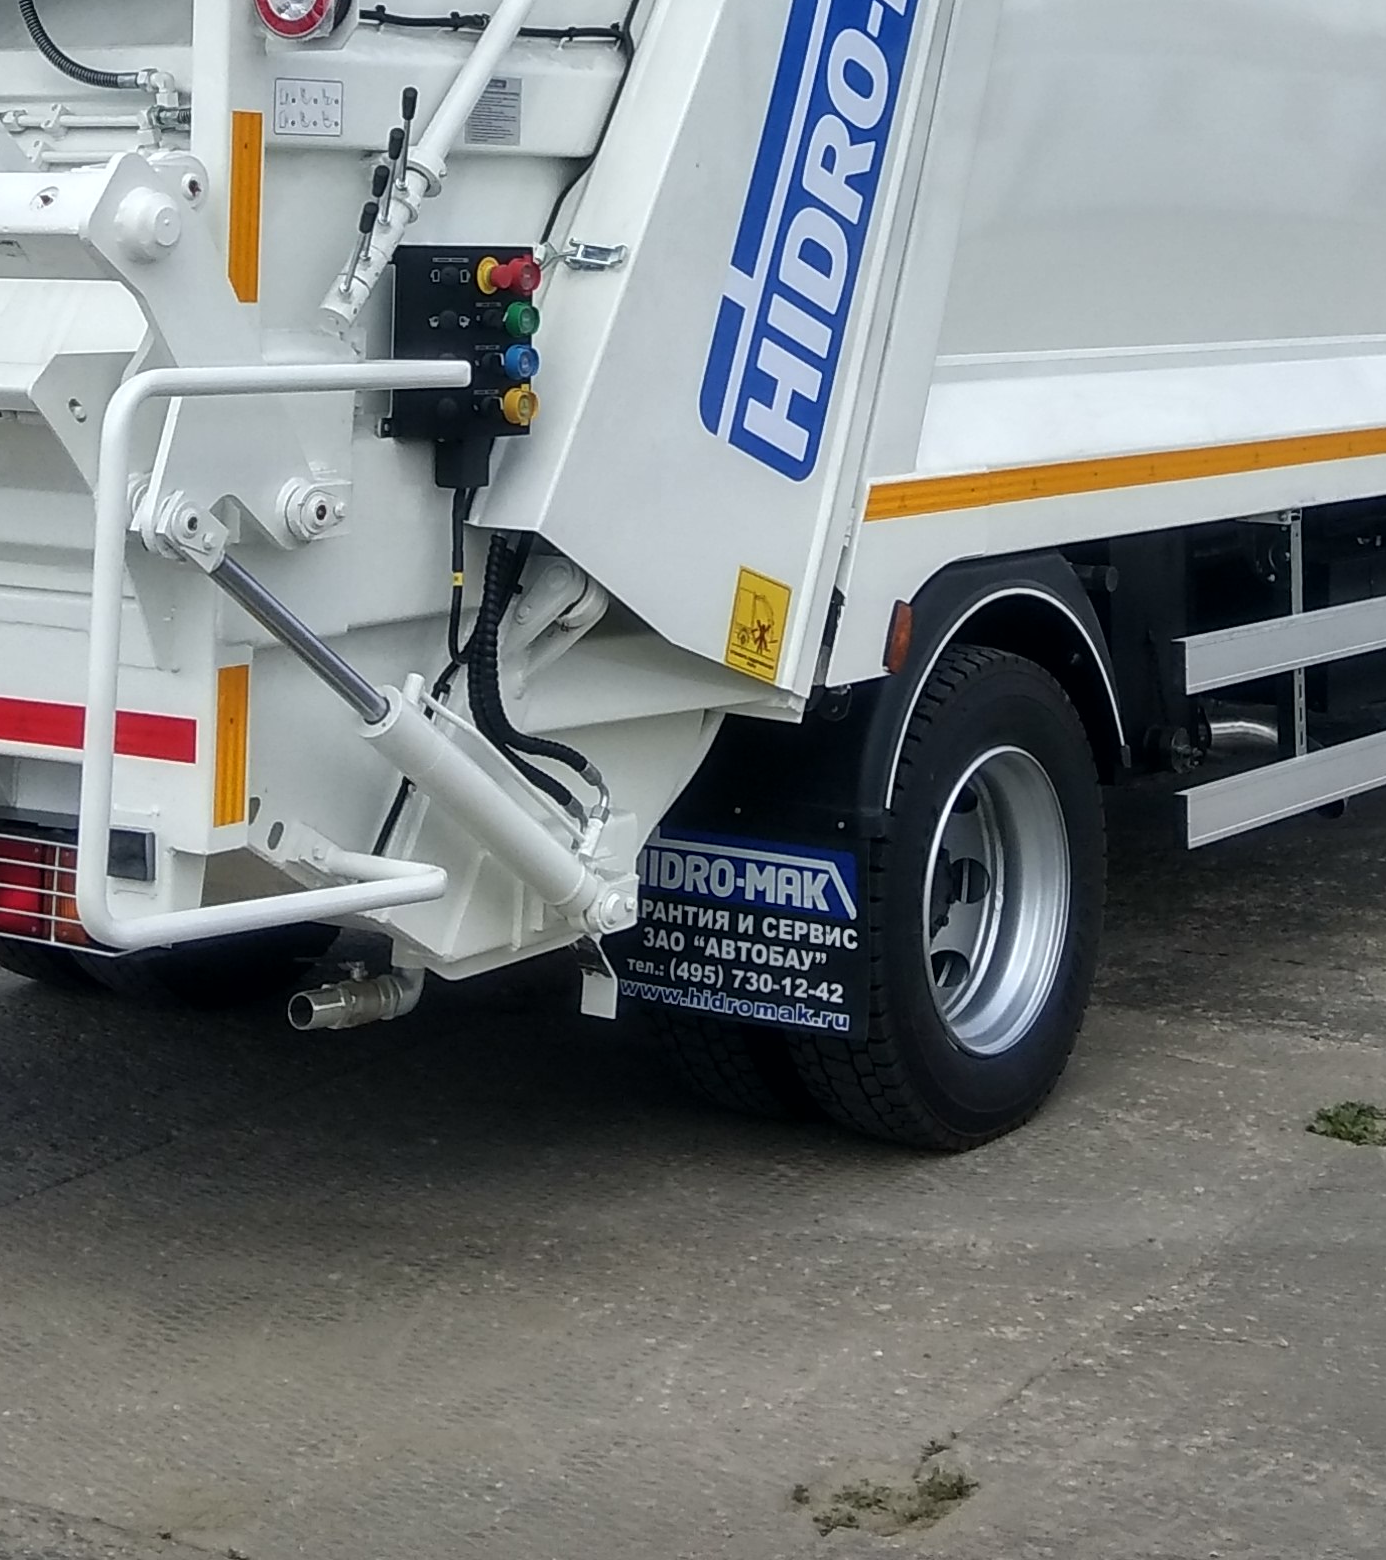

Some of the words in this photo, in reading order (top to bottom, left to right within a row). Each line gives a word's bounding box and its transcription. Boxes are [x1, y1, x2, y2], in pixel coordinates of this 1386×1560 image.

[637, 897, 730, 932] РАНТИЯ
[738, 912, 754, 934] И
[762, 916, 859, 950] СЕРВИС
[642, 927, 685, 952] ЗАО
[619, 978, 850, 1031] www.hidromak.ru
[626, 957, 665, 978] тел.:
[669, 958, 724, 987] (495)
[731, 969, 844, 1004] 730-12-42
